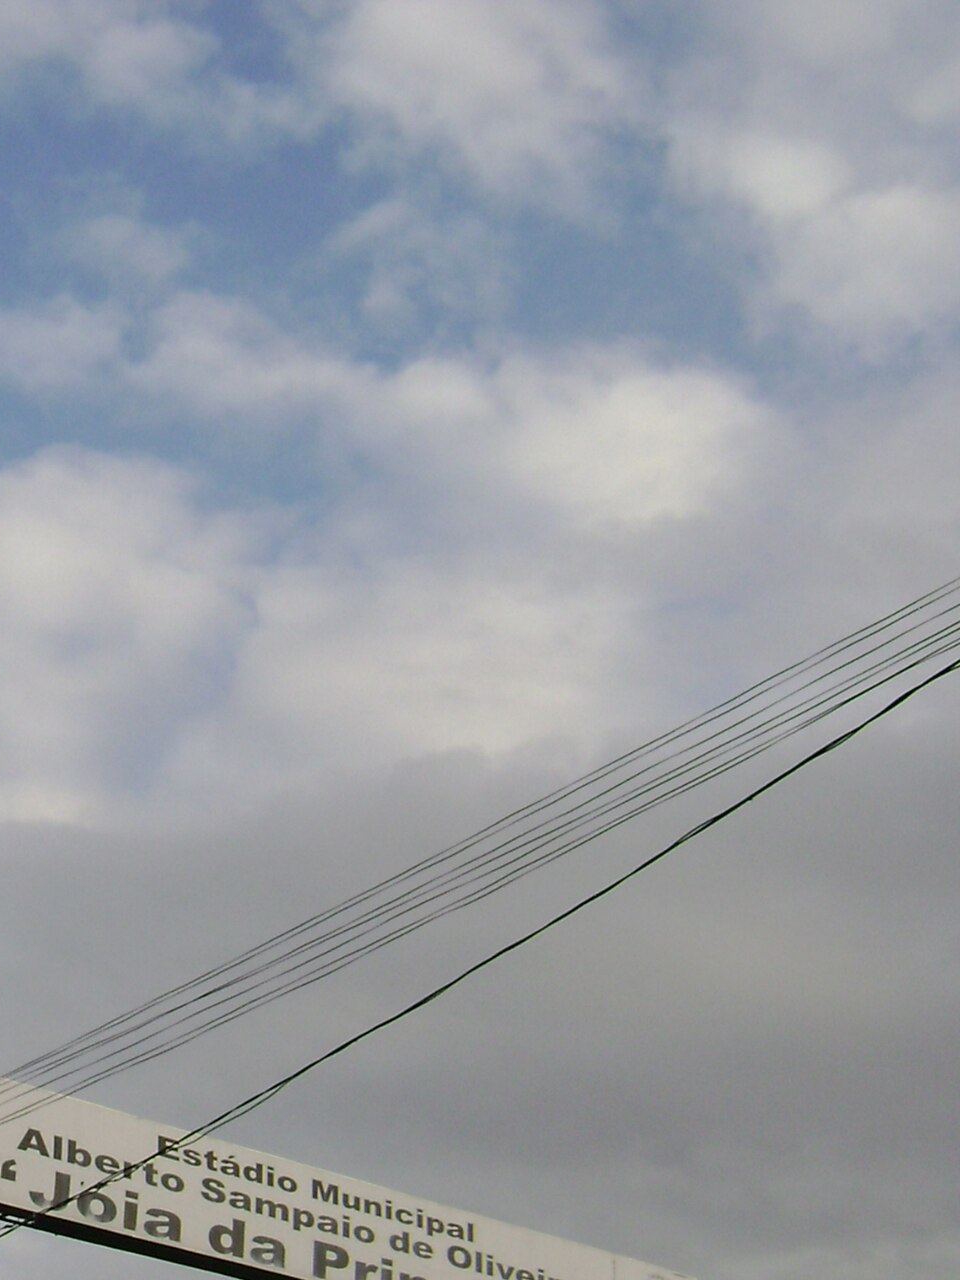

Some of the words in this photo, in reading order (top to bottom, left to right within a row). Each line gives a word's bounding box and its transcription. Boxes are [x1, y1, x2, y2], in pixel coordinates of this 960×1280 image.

[17, 1128, 185, 1193] Alberto
[201, 1177, 375, 1244] Sampaio
[389, 1231, 434, 1260] de
[158, 1135, 298, 1193] Estádio
[312, 1178, 474, 1243] Municipal
[208, 1218, 286, 1269] da
